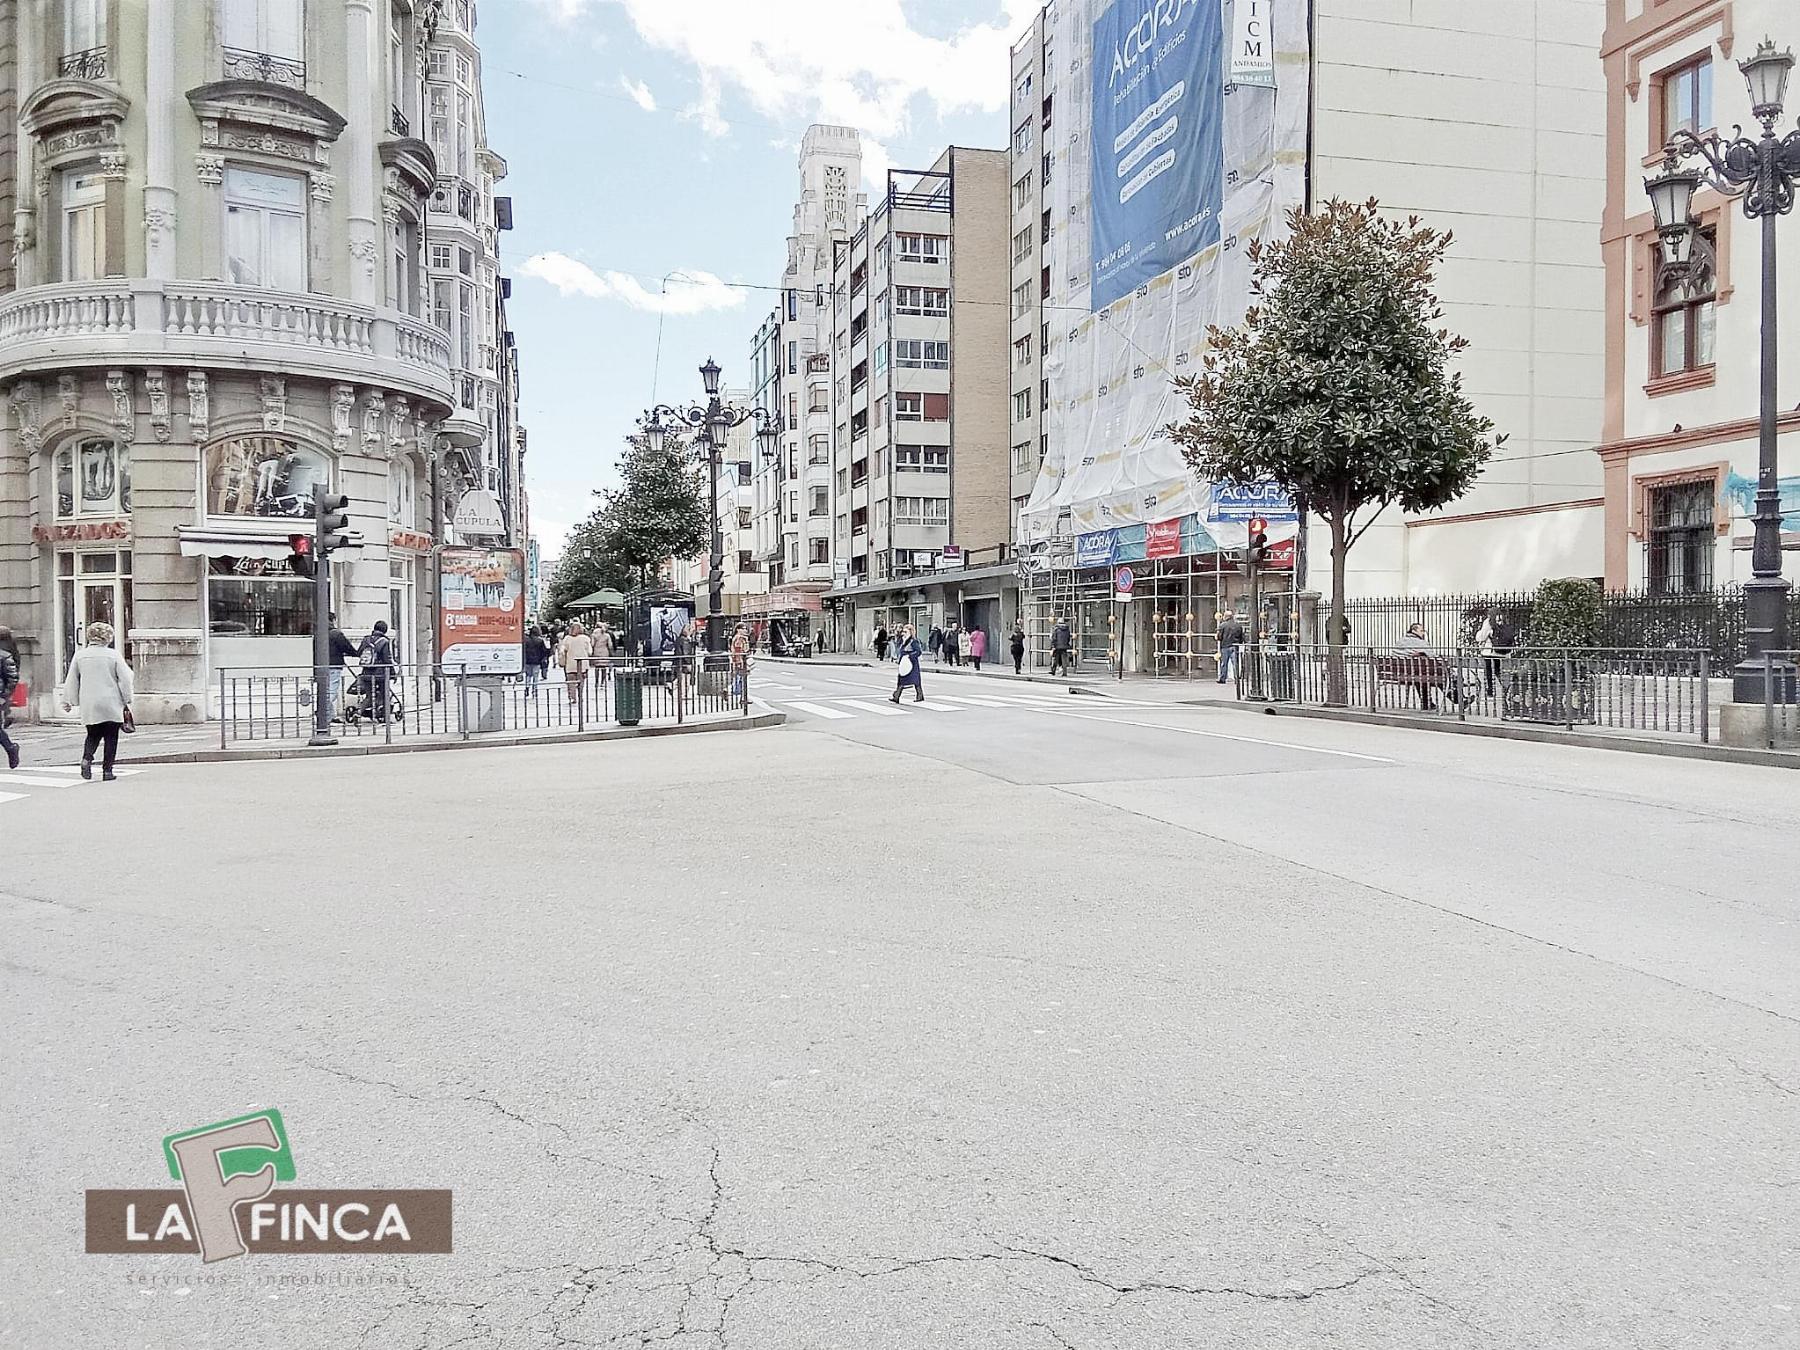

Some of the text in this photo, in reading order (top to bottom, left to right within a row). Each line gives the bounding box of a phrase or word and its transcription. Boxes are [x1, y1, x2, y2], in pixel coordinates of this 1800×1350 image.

[1233, 60, 1272, 69] ANDAMIOS
[1177, 264, 1191, 280] sto
[1133, 364, 1145, 380] sto
[458, 507, 478, 517] LA
[455, 517, 501, 527] CUPULA
